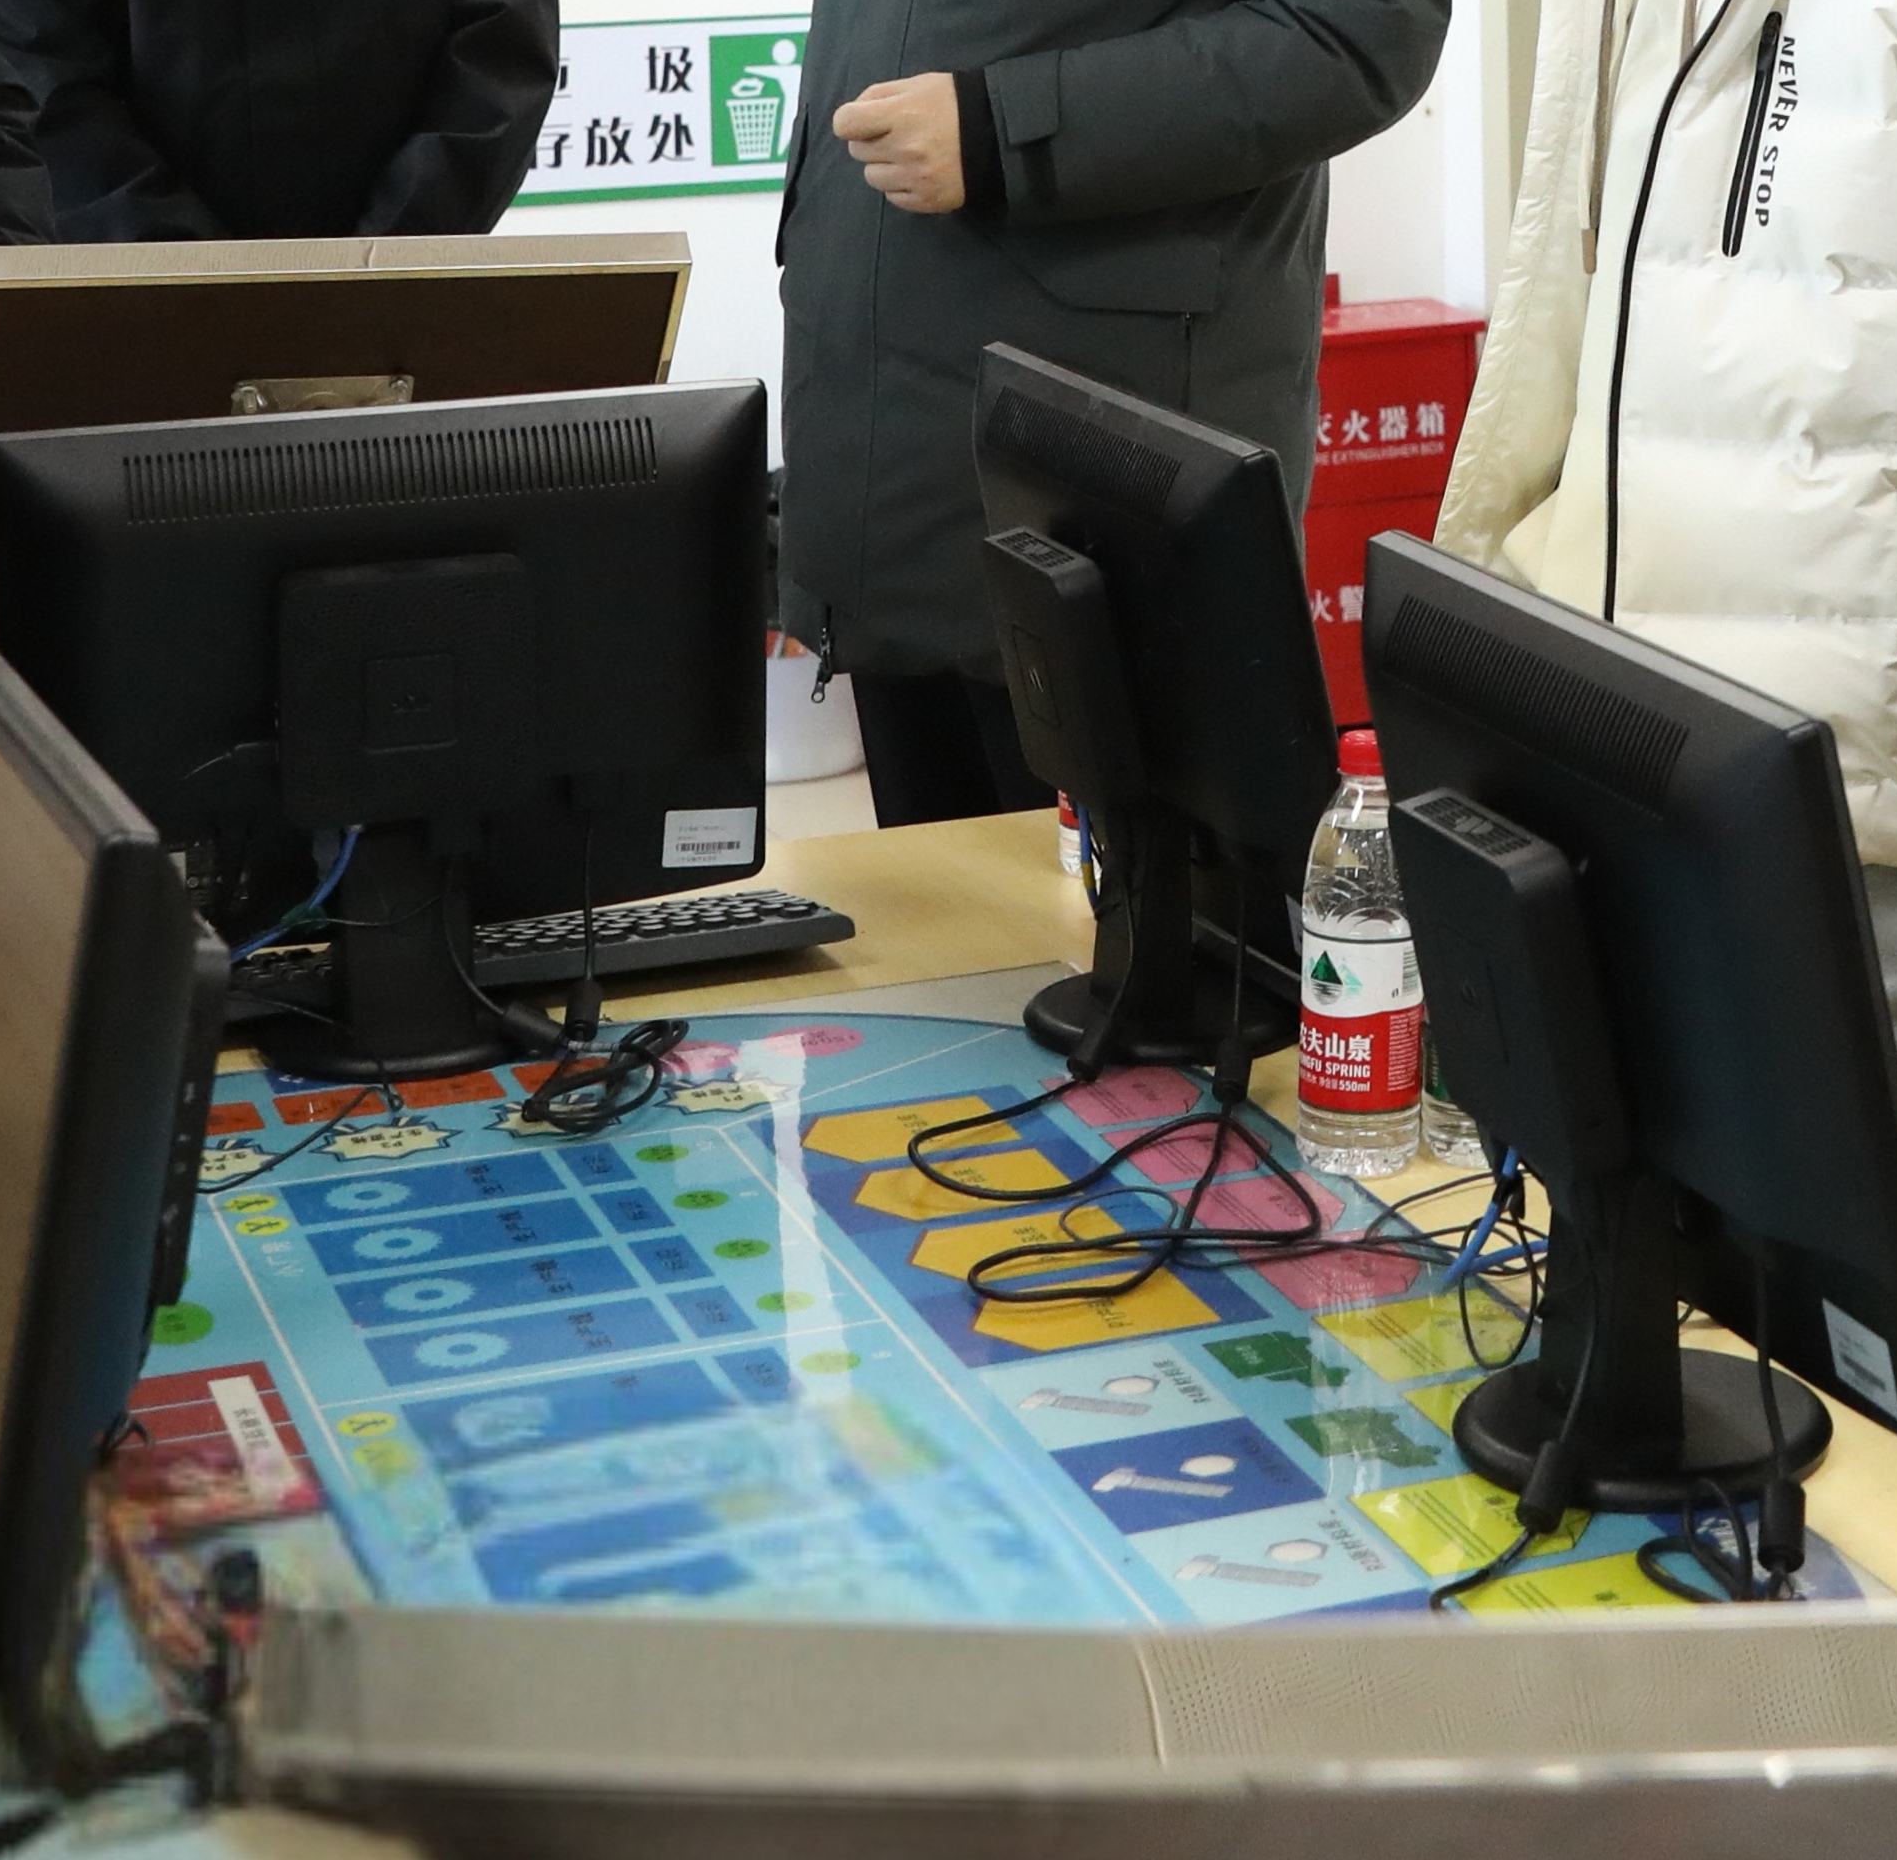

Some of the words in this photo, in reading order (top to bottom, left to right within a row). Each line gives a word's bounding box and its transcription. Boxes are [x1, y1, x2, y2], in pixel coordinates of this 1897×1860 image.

[1768, 36, 1799, 132] NEVER
[1755, 144, 1779, 227] STOP
[1325, 1061, 1371, 1078] SPRING
